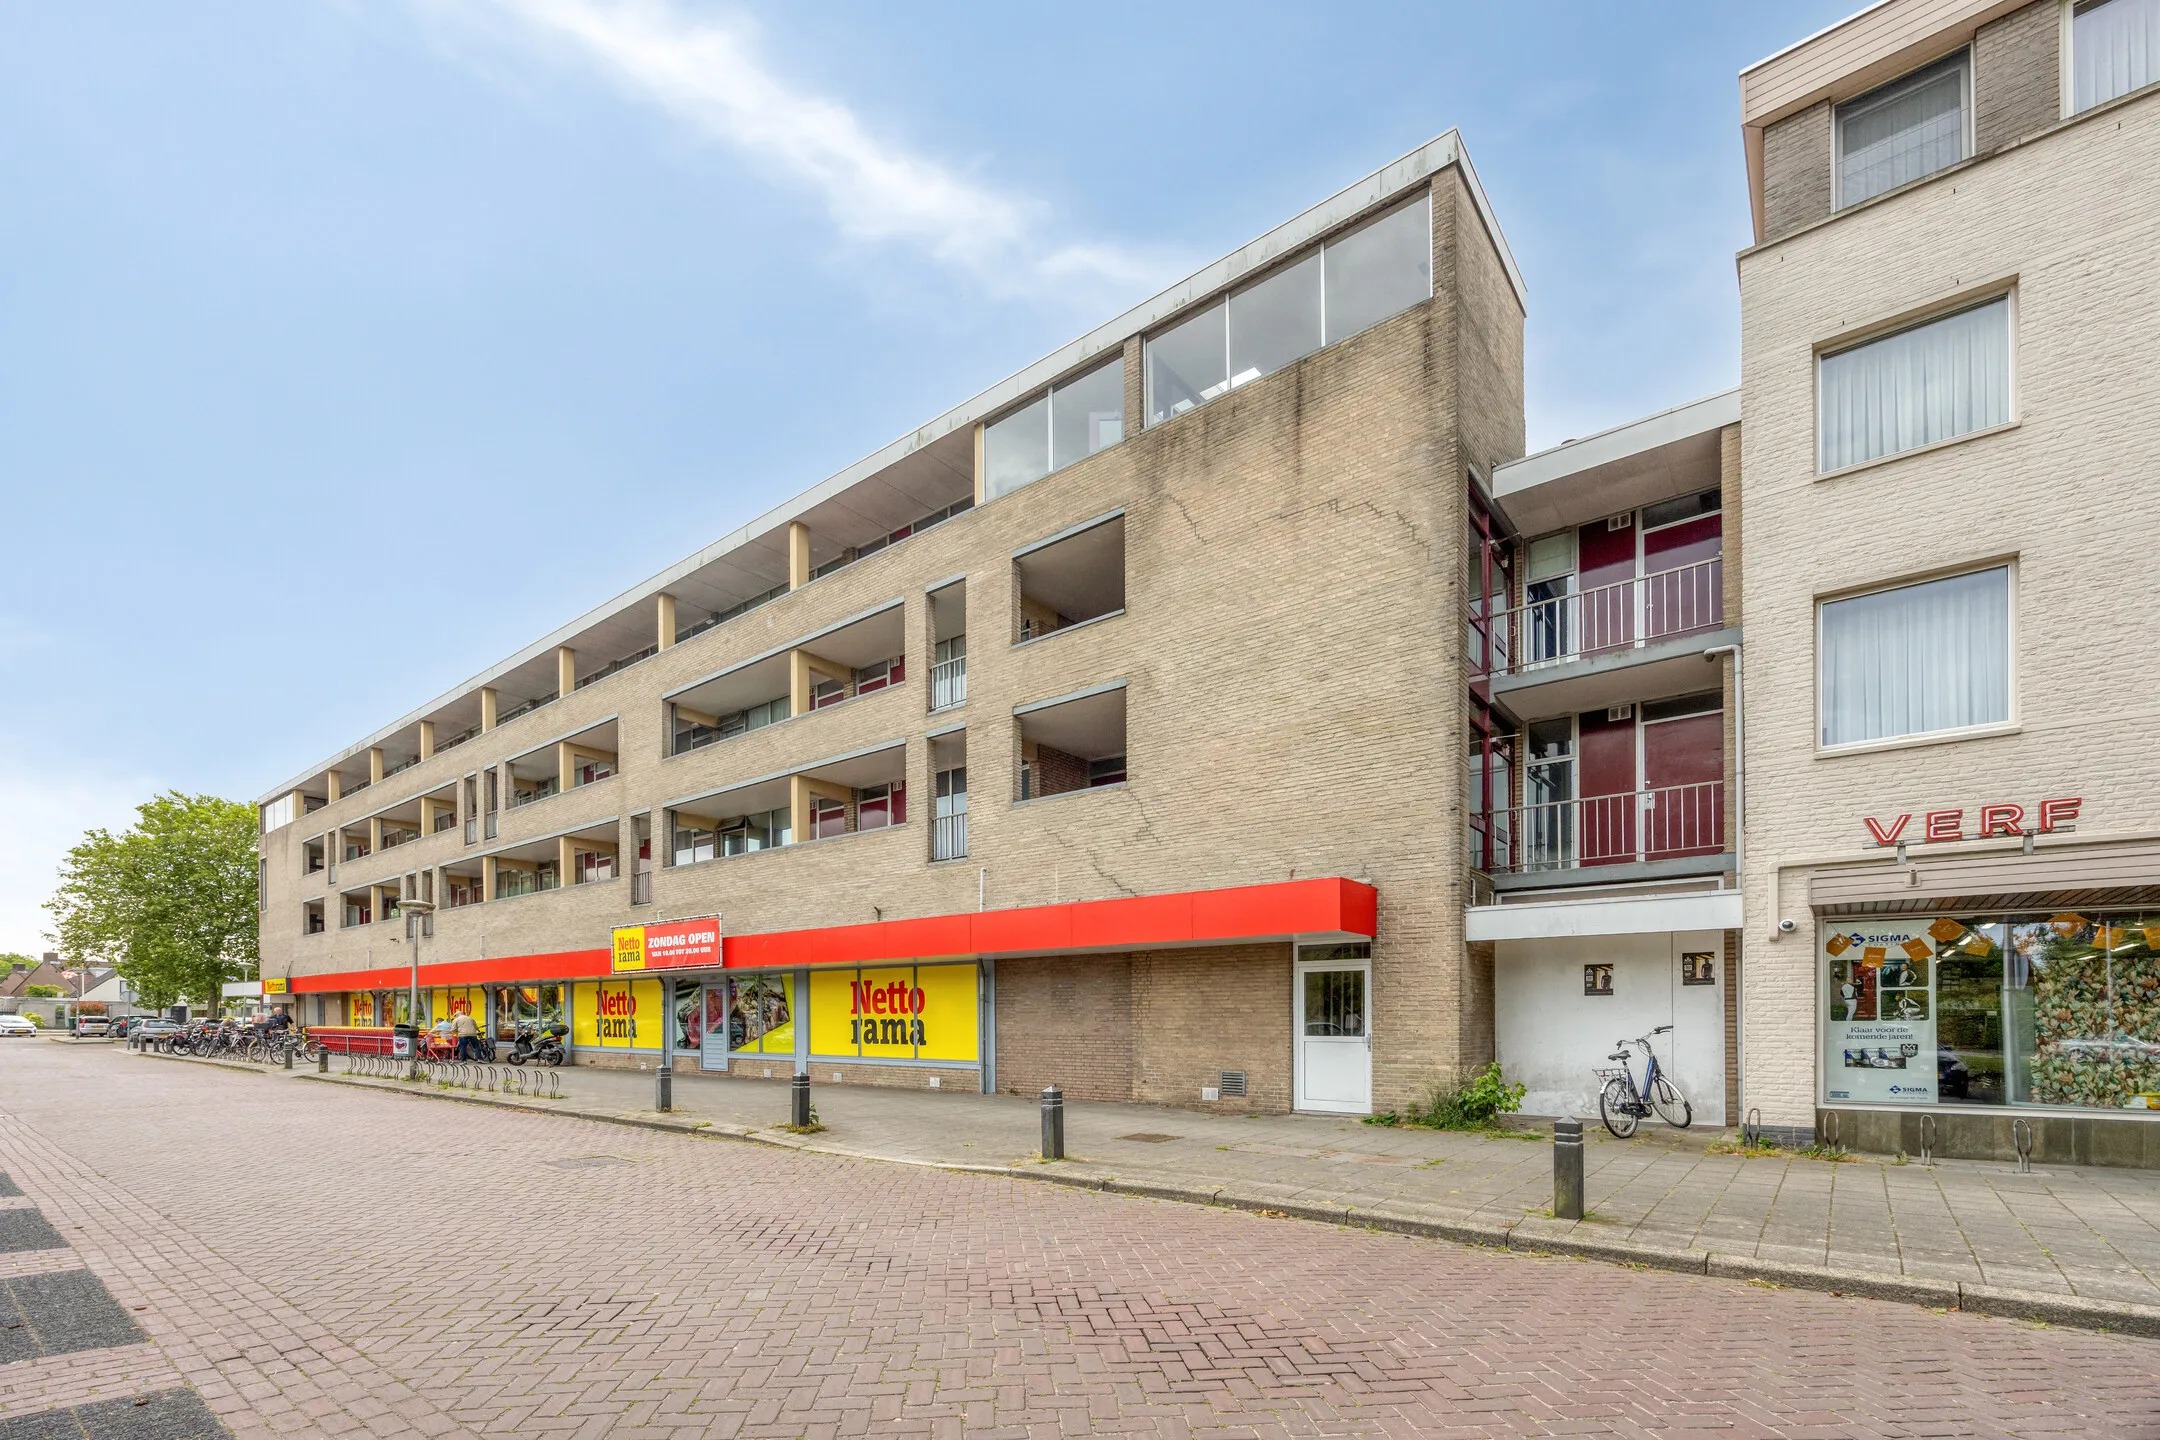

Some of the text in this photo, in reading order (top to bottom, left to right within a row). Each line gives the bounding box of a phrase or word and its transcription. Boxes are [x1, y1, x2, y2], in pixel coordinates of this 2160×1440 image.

[1863, 797, 2082, 846] VERF
[618, 937, 640, 951] Netto
[648, 932, 715, 948] ZONDAG OPEN
[1868, 934, 1911, 943] SIGMA
[618, 950, 640, 963] rama
[596, 990, 637, 1016] Netto
[850, 980, 926, 1014] Netto
[596, 1018, 637, 1038] rama
[850, 1018, 927, 1046] rama
